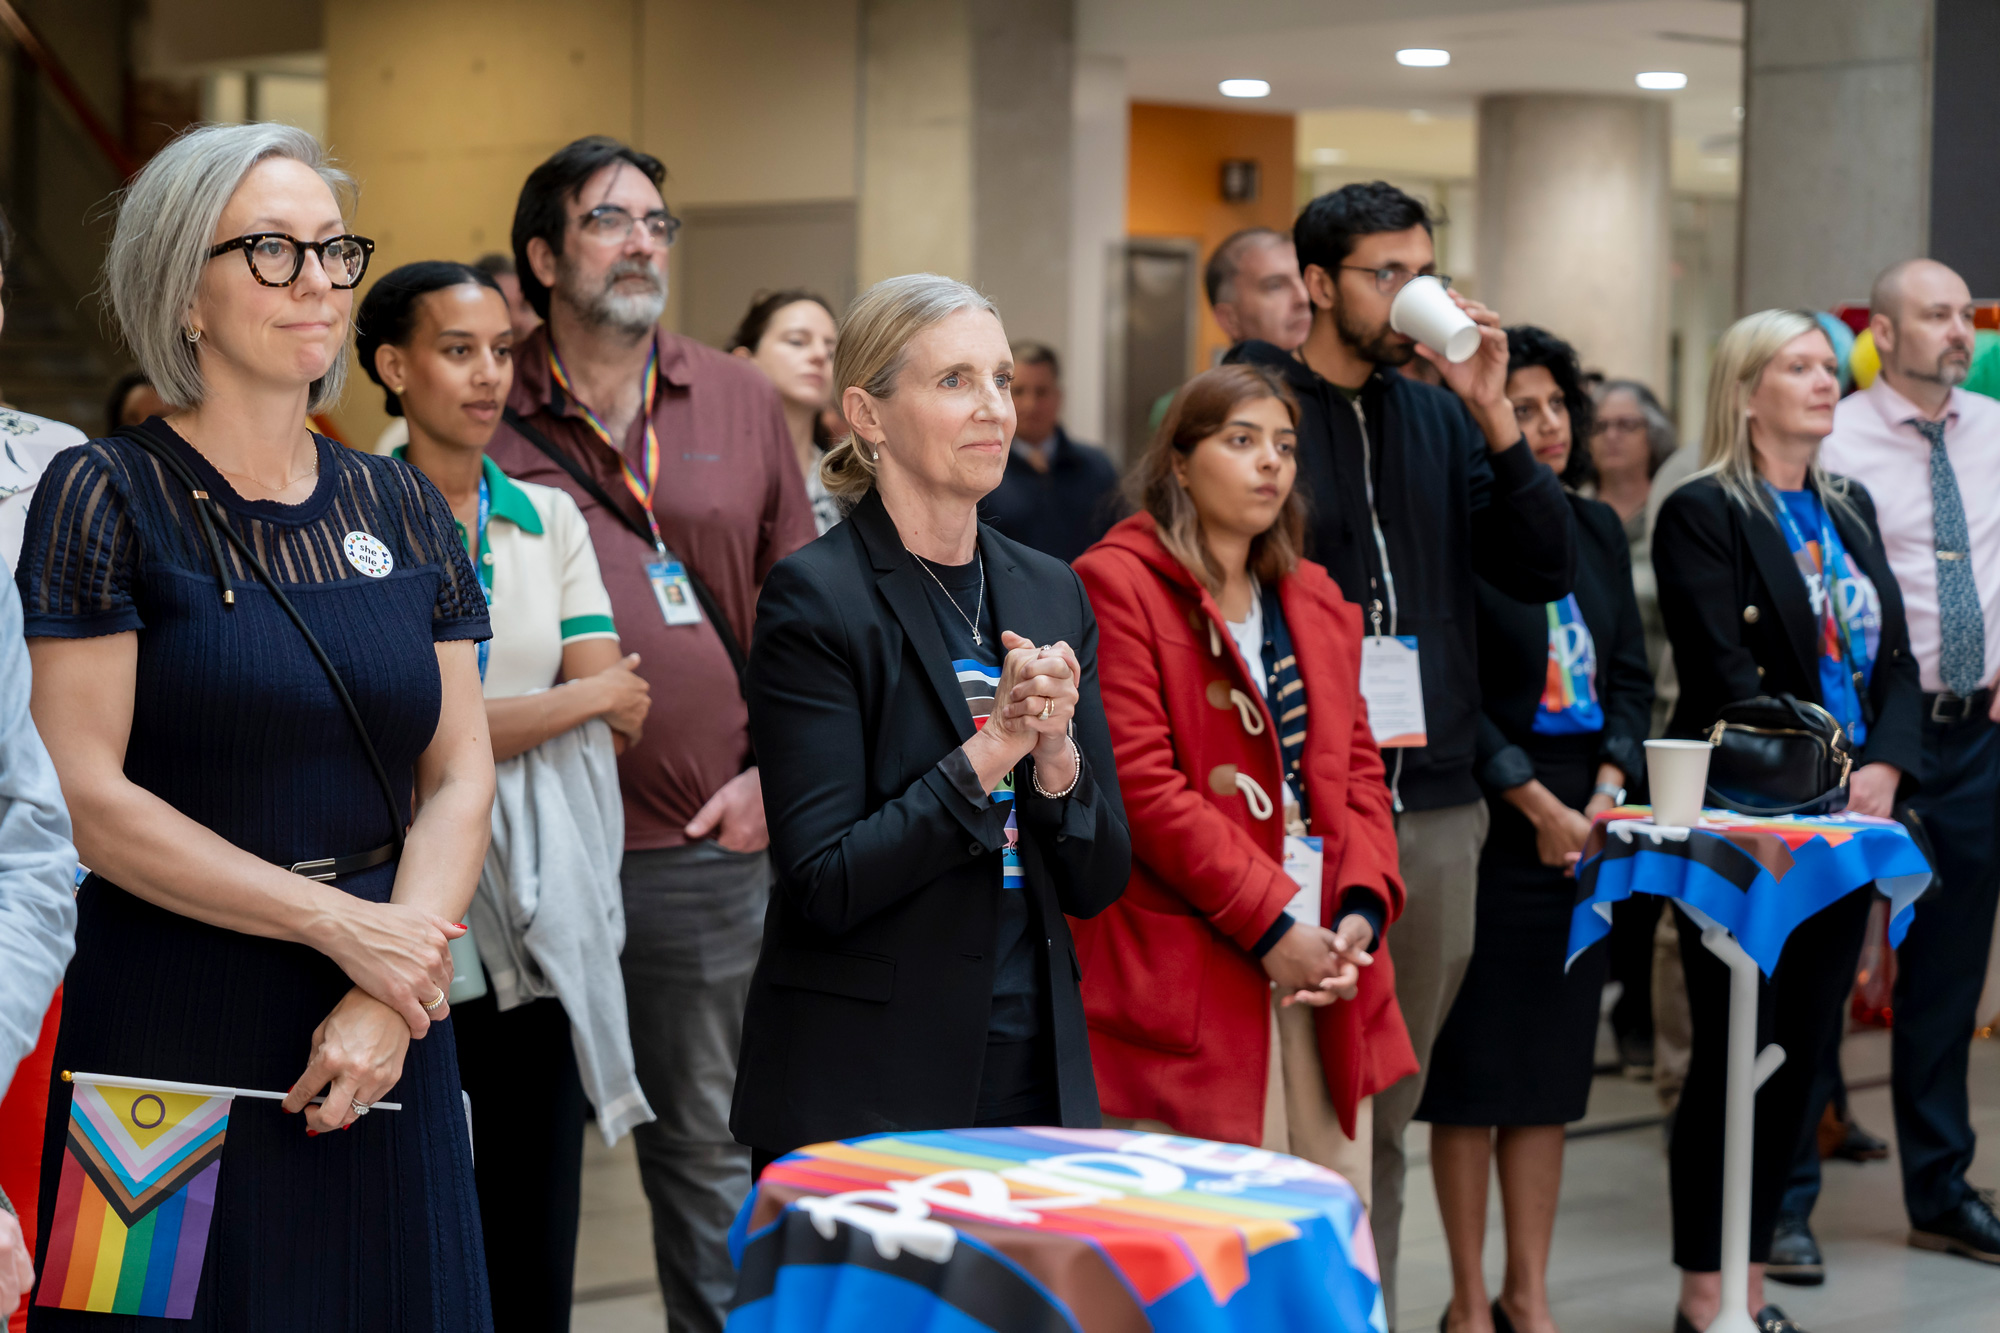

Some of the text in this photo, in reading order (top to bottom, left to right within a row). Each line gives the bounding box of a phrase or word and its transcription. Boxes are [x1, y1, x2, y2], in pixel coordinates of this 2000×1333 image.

[359, 544, 377, 557] she
[359, 554, 377, 567] elle
[796, 1133, 1274, 1264] PRIDE
